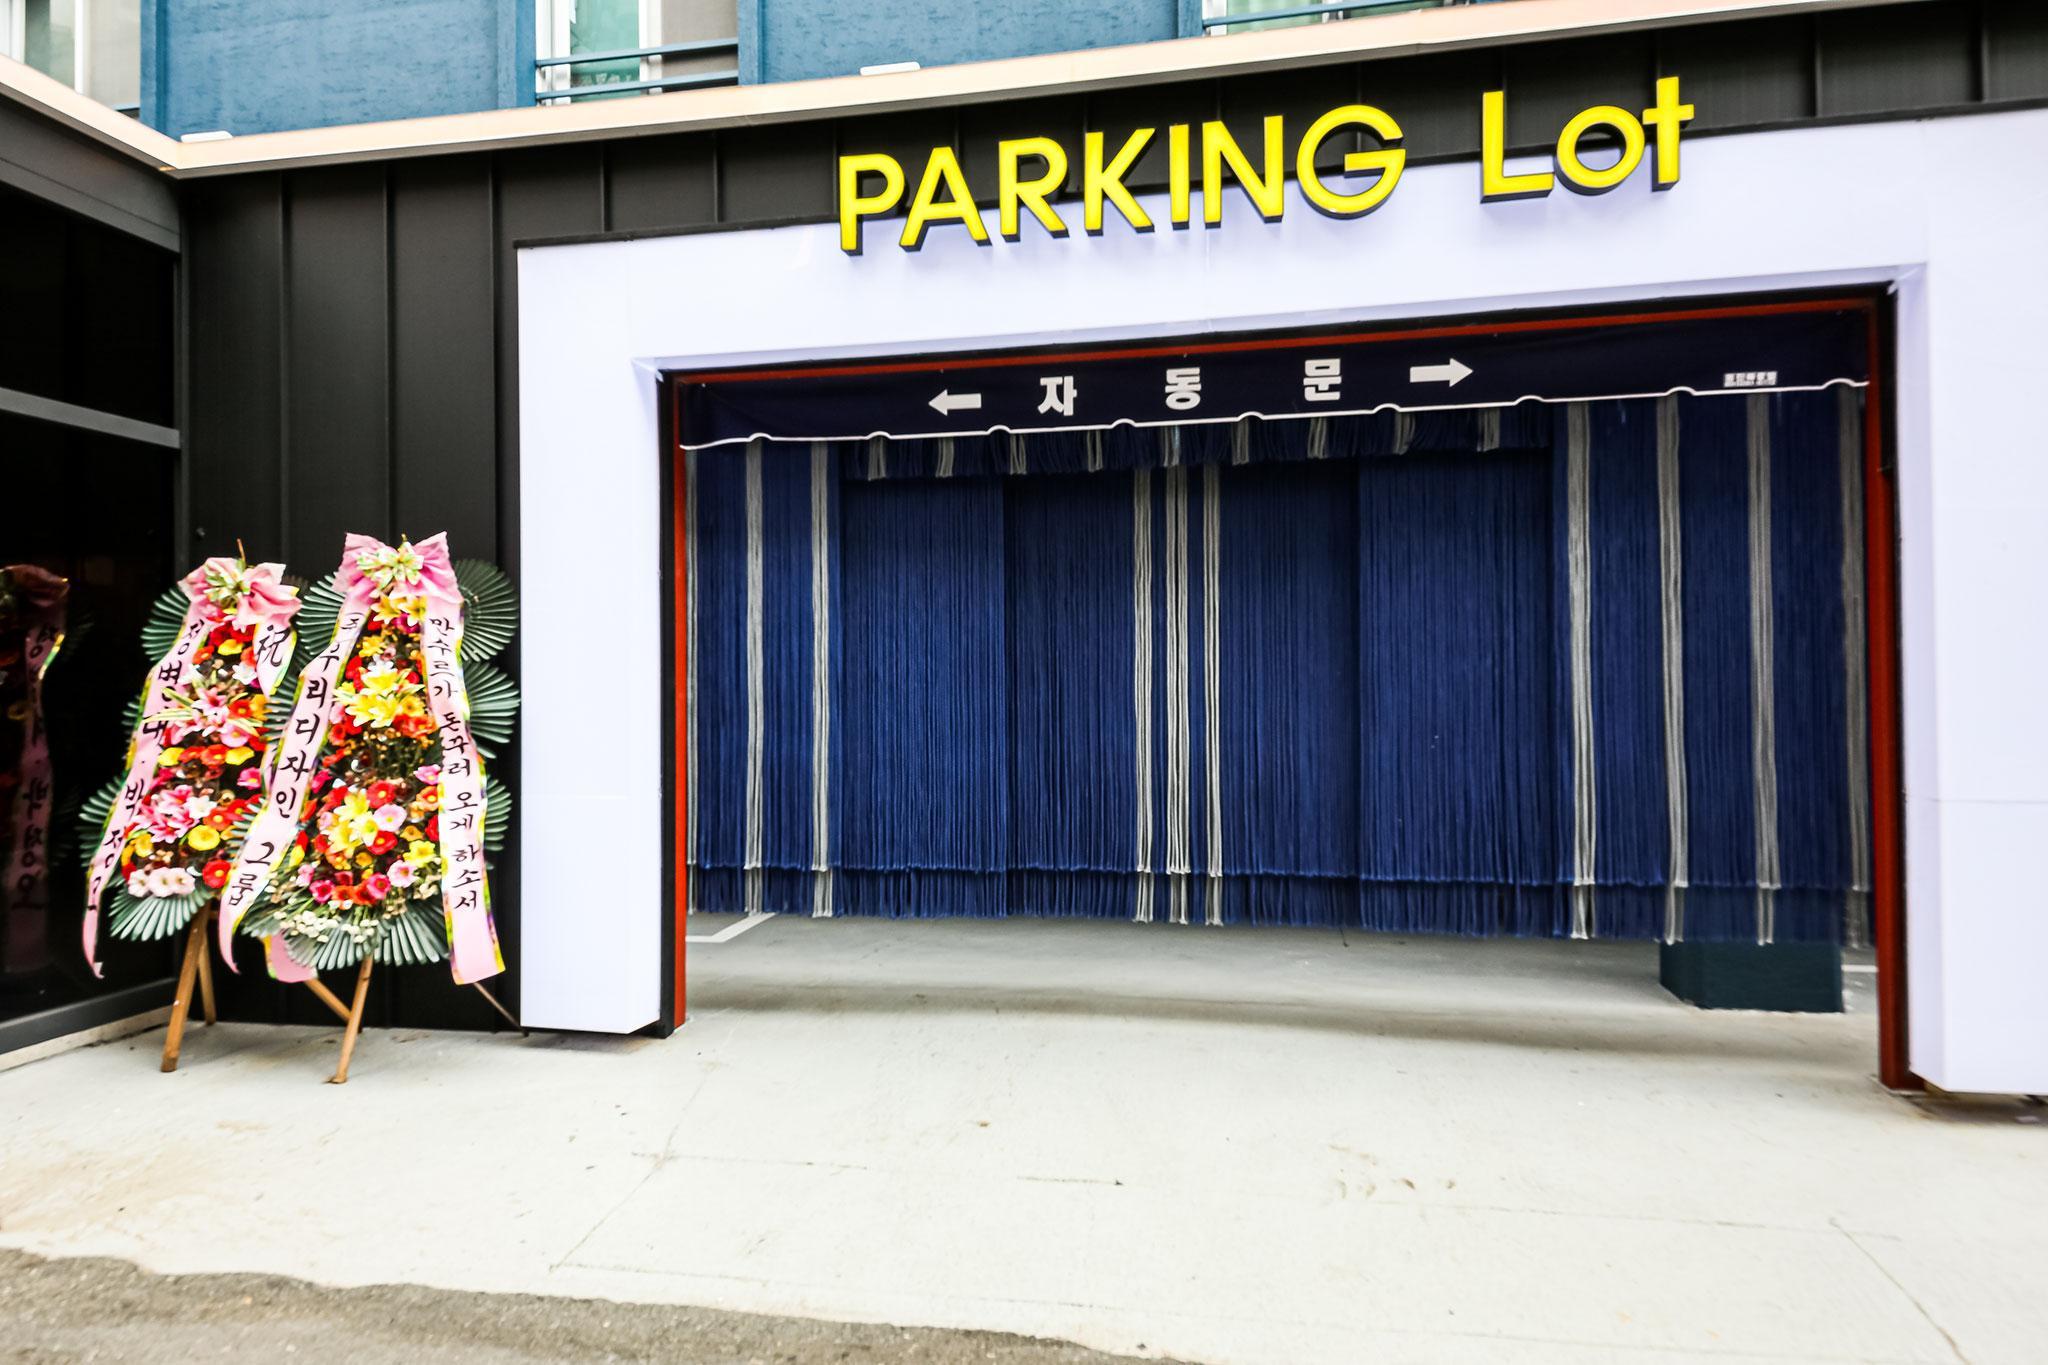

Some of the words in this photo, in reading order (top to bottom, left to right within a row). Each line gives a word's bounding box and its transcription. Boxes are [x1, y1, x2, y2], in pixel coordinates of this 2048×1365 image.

[838, 105, 1406, 255] PARKING
[1481, 77, 1696, 201] Lot
[256, 624, 293, 667] 祝
[427, 616, 458, 699] 만수르가
[451, 844, 481, 911] 하소서
[229, 842, 275, 906] 그룹
